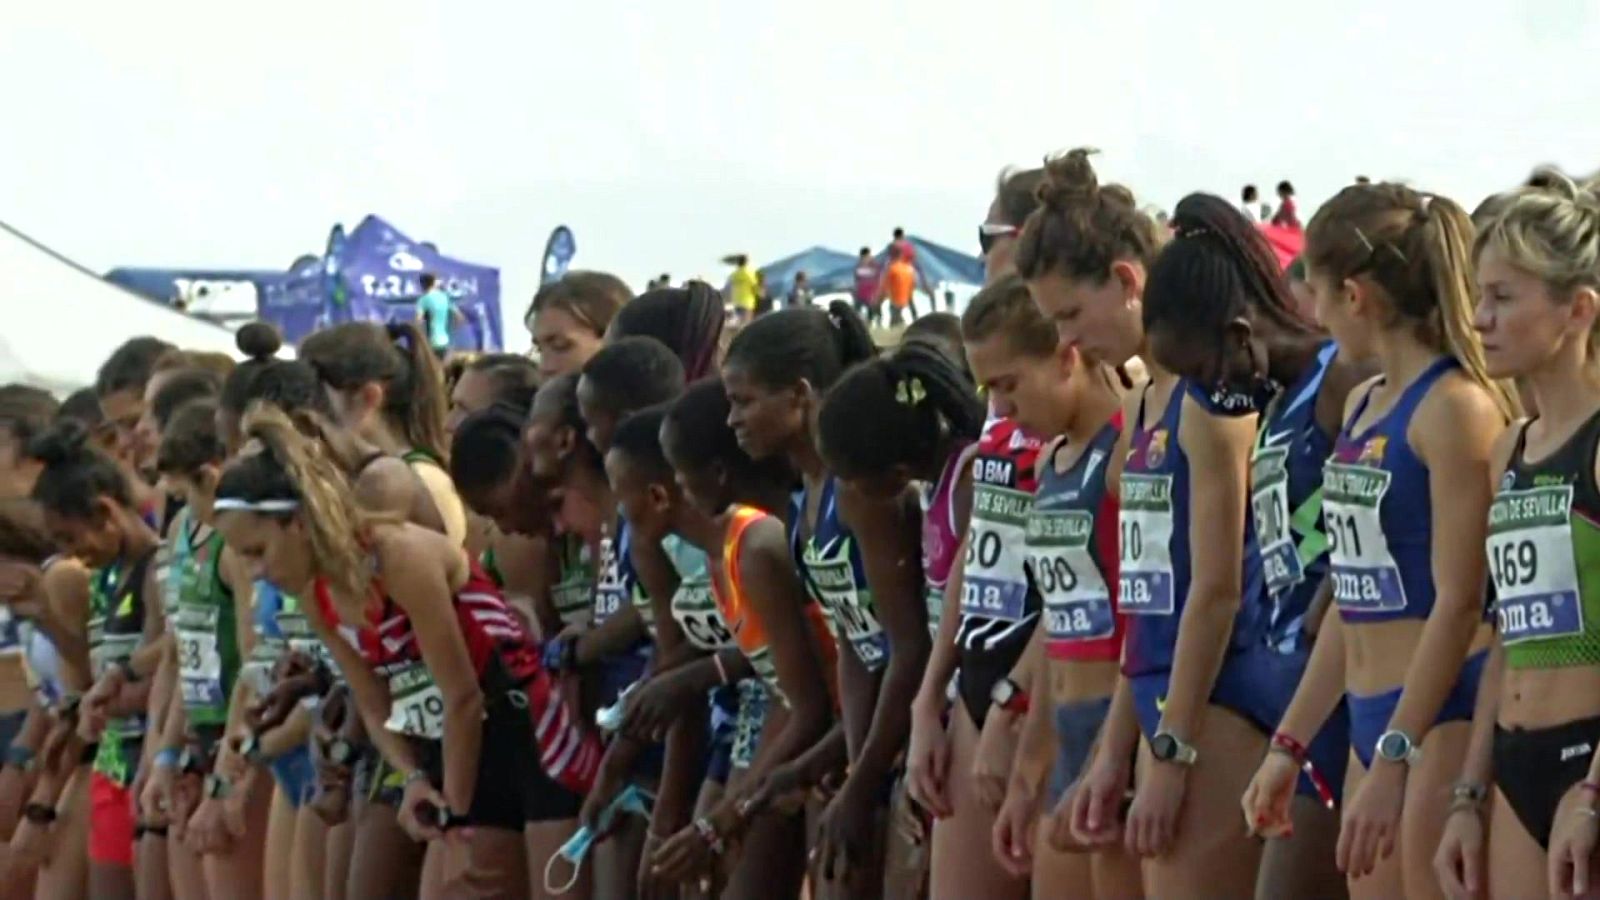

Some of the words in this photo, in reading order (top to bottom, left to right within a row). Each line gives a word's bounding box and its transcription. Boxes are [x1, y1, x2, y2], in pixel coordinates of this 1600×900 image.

[984, 460, 1012, 486] BM
[1510, 497, 1521, 520] DE
[1522, 492, 1567, 519] SEVILLA
